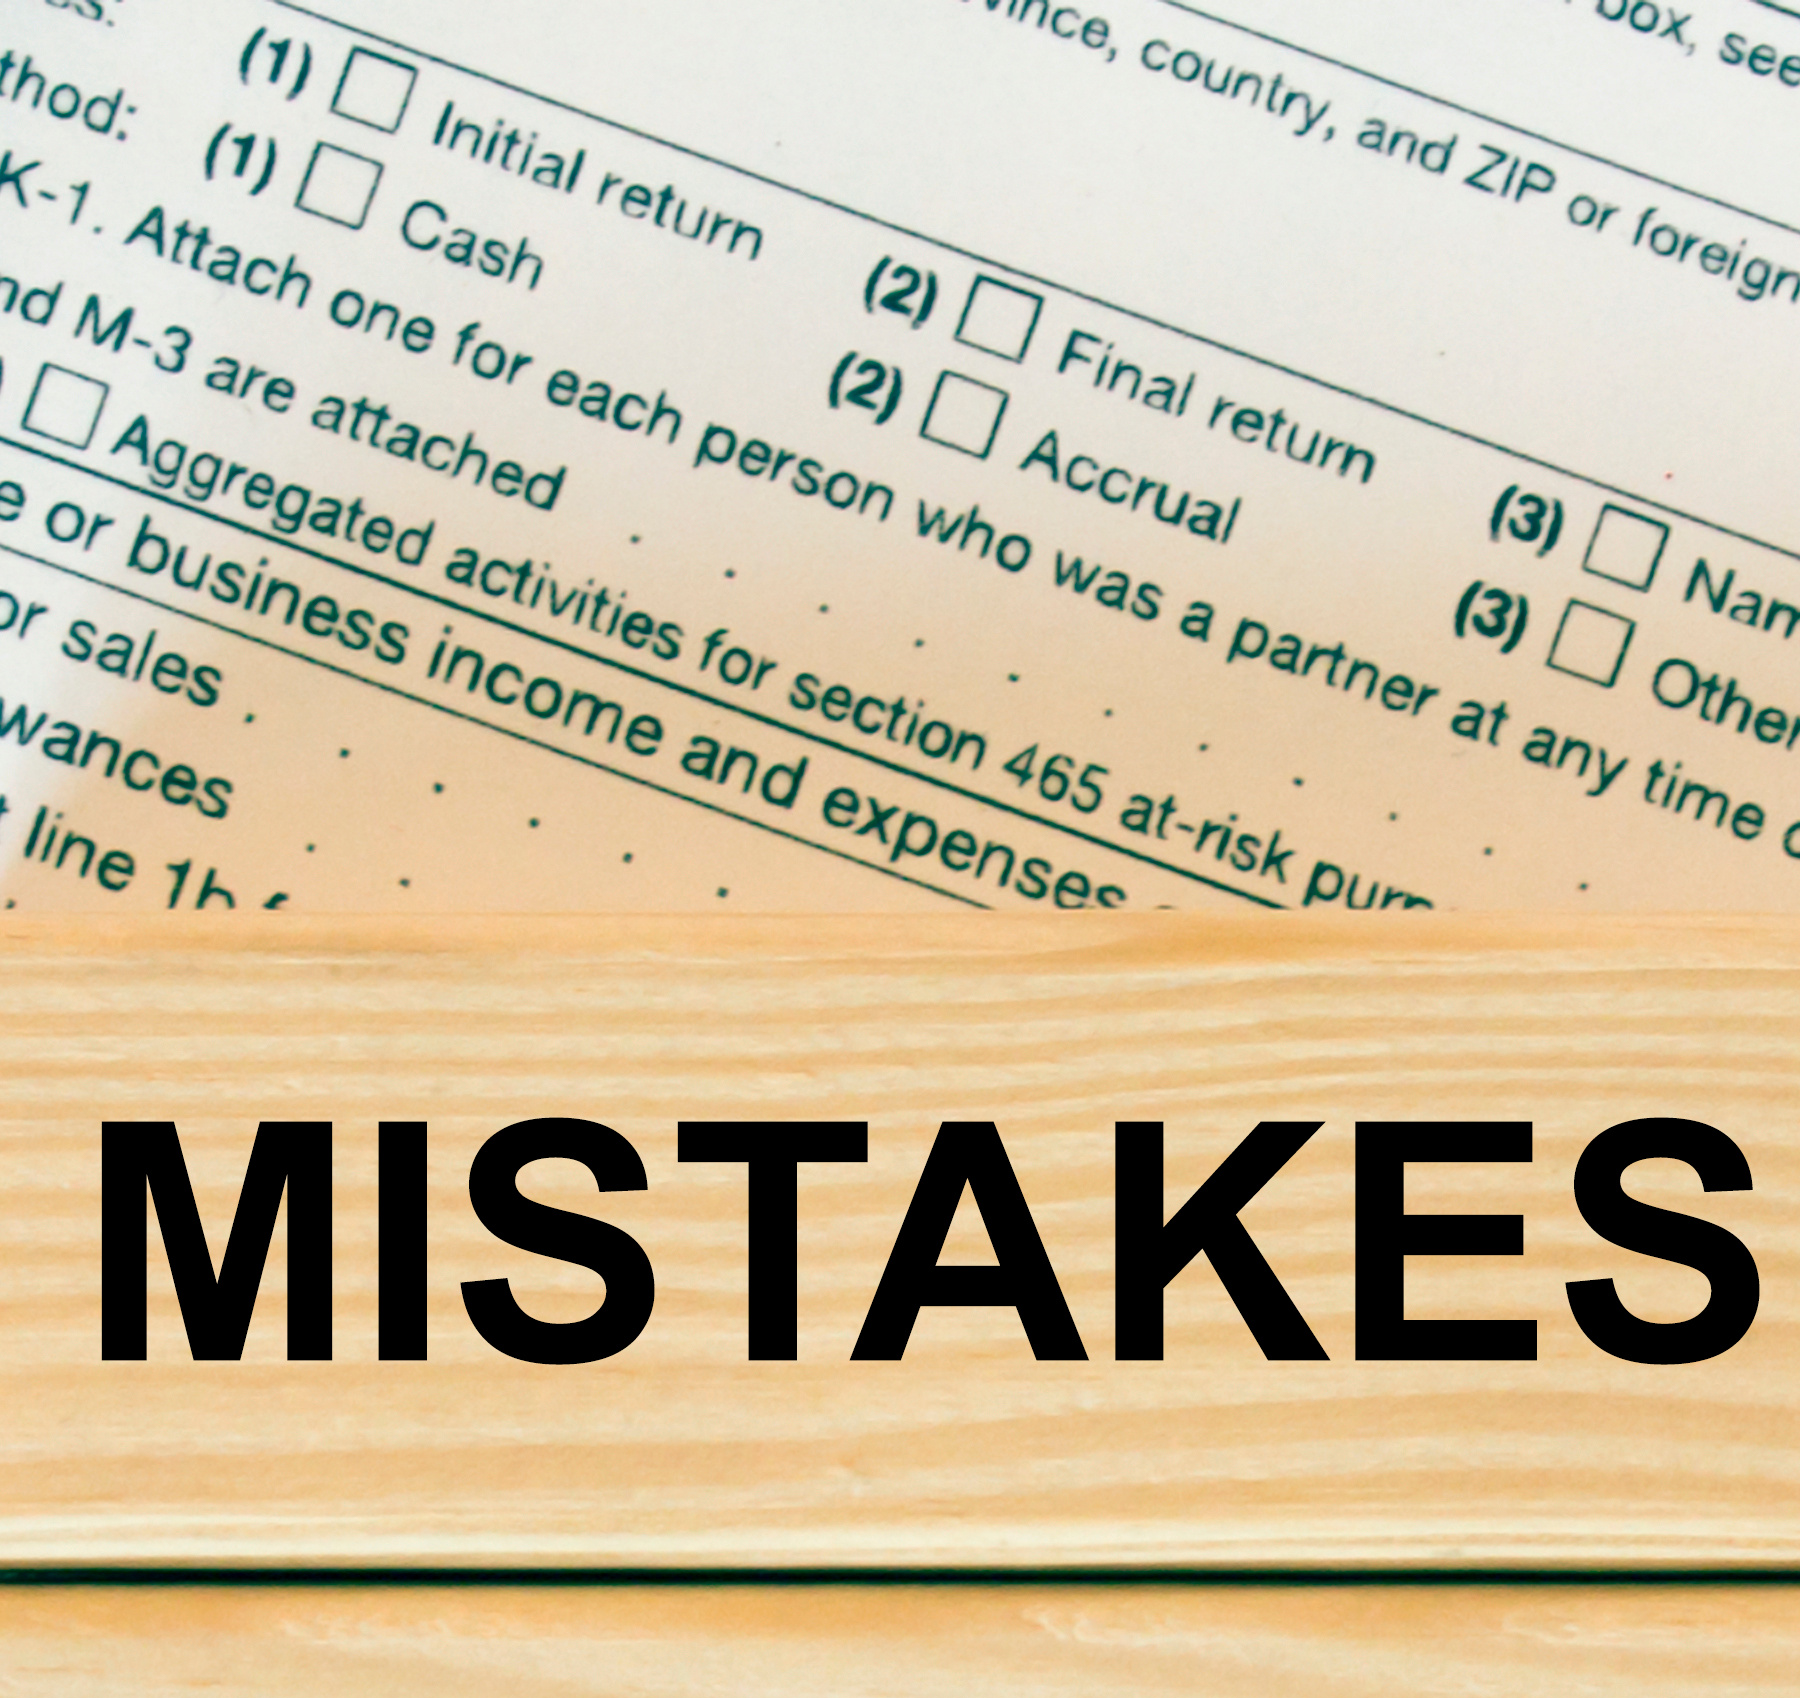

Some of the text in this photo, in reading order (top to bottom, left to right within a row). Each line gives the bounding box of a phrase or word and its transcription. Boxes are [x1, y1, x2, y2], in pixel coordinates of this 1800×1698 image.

[1139, 37, 1336, 143] country,
[1355, 117, 1460, 176] and
[1462, 142, 1558, 204] ZIP
[1566, 193, 1621, 233] or
[202, 121, 279, 198] (1)
[399, 198, 545, 292] Cash
[826, 349, 905, 427] (2)
[1017, 428, 1243, 546] Accrual
[1452, 578, 1531, 656] (3)
[237, 25, 314, 102] (1)
[431, 99, 588, 195] Initial
[595, 171, 765, 262] return
[861, 253, 940, 332] (2)
[1056, 327, 1197, 418] Final
[1206, 394, 1378, 486] return
[1488, 482, 1566, 560] (3)
[43, 500, 116, 552] or
[124, 512, 411, 667] business
[425, 623, 666, 758] income
[678, 733, 811, 811] and
[59, 618, 224, 709] sales
[122, 204, 314, 310] Attach
[327, 287, 437, 355] one
[451, 320, 535, 386] for
[544, 368, 684, 446] each
[691, 421, 896, 524] person
[916, 498, 1034, 575] who
[1053, 549, 1165, 623] was
[1177, 599, 1217, 644] a
[1224, 616, 1442, 718] partner
[1448, 698, 1511, 748] at
[1520, 725, 1630, 799] any
[1642, 758, 1768, 843] time
[100, 1115, 1762, 1367] MISTAKES
